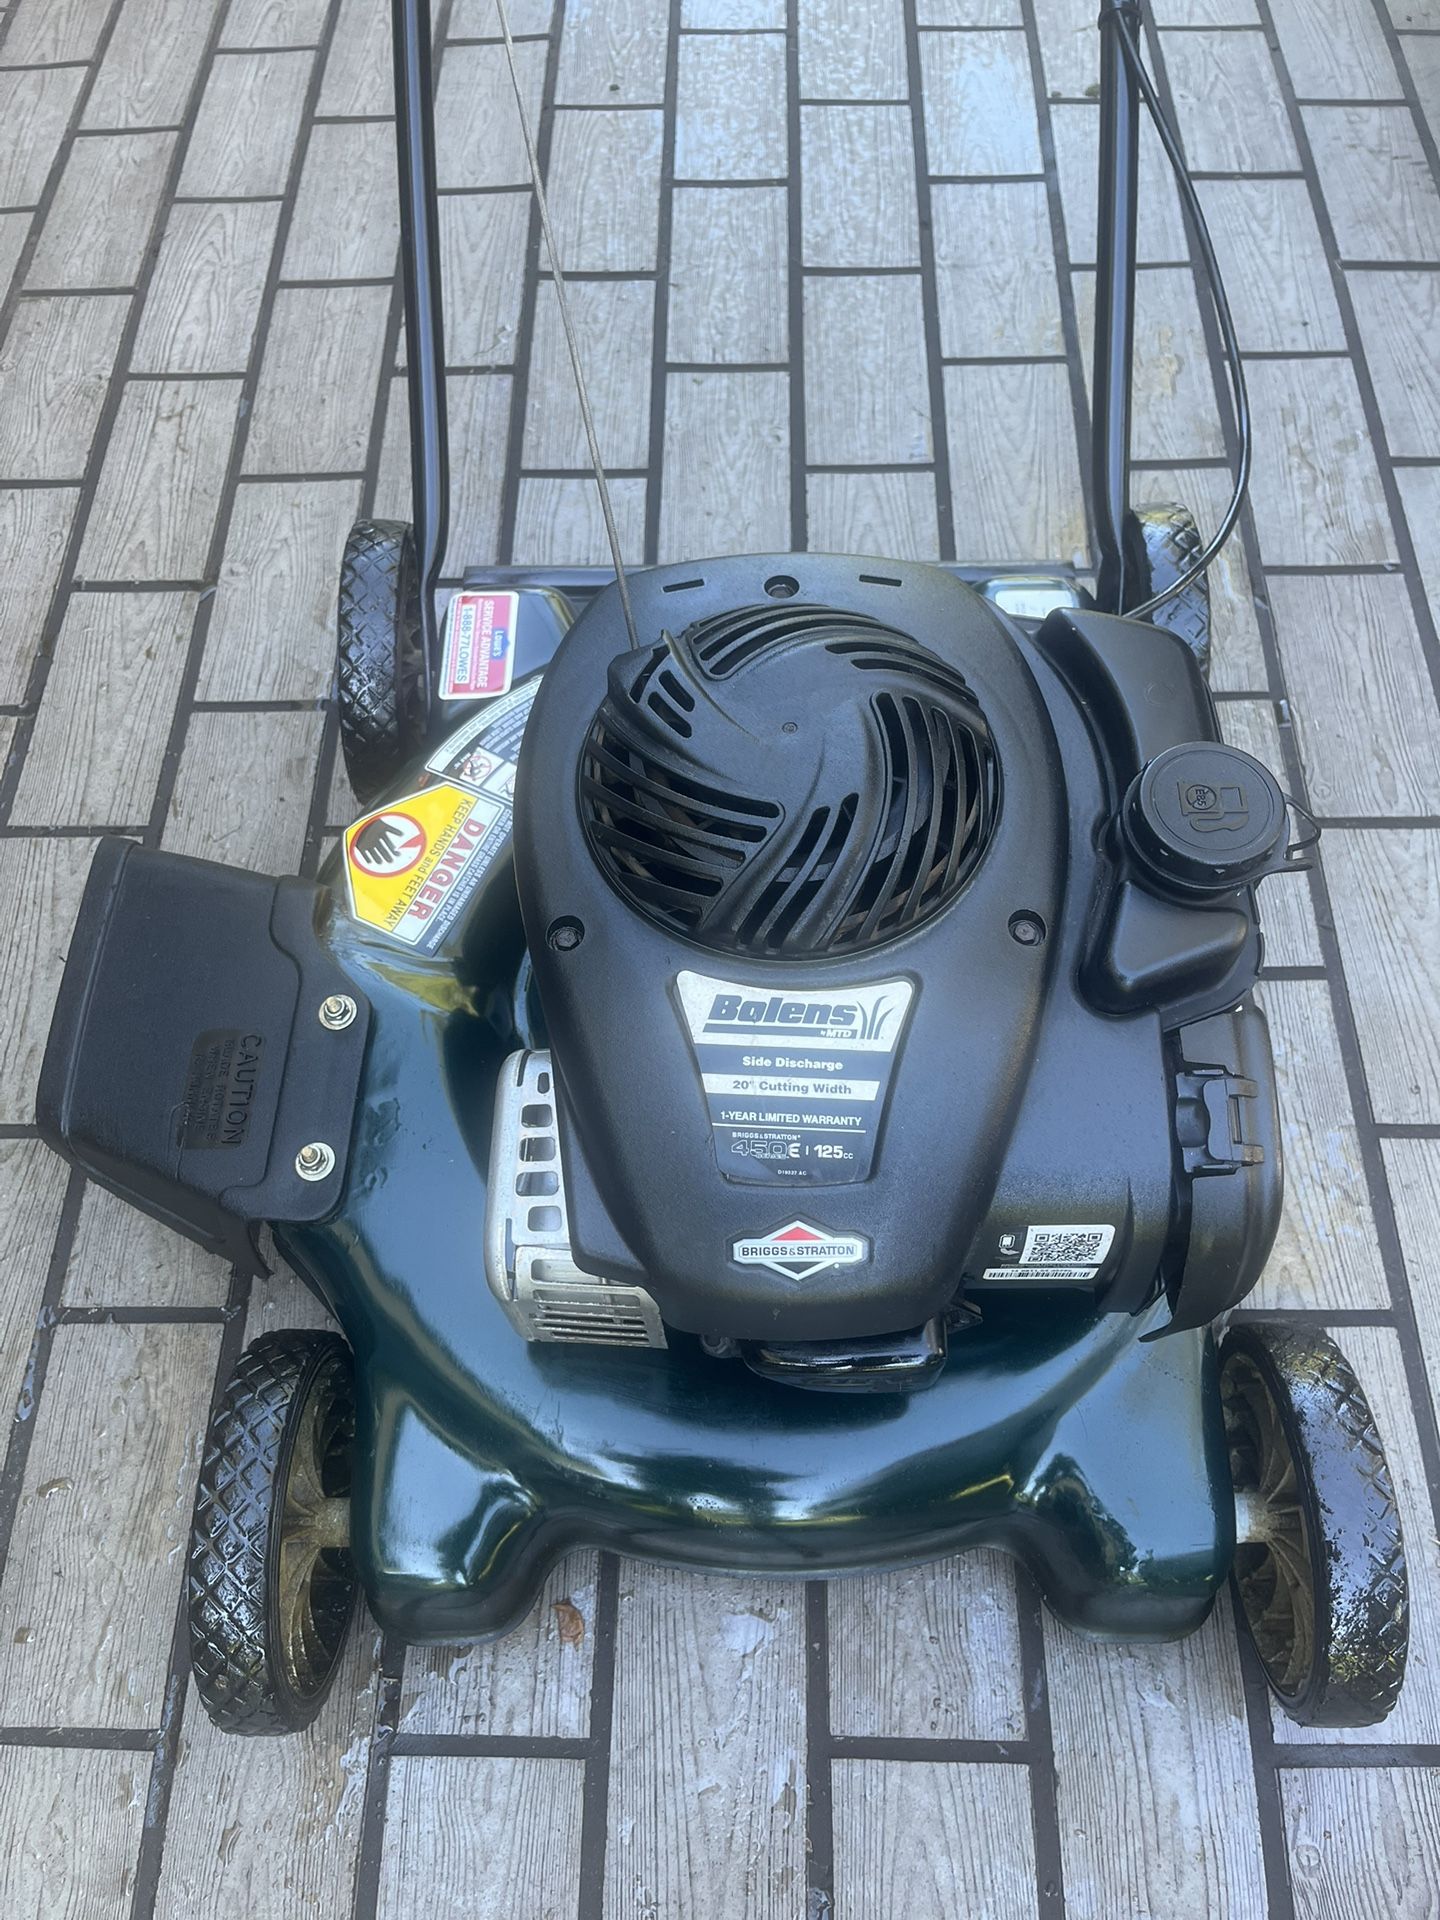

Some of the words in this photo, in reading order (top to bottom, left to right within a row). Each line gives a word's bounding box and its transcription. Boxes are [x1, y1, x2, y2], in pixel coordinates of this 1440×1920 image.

[481, 600, 495, 636] SERVICE
[456, 607, 473, 682] 1-888-77LOWES
[476, 637, 492, 688] ADVANTAGE
[449, 798, 472, 824] KEEP
[428, 823, 456, 857] HANDS
[486, 830, 506, 857] OPERATE
[407, 816, 486, 923] DANGER
[417, 855, 435, 875] and
[473, 855, 491, 878] UNLESS
[401, 873, 423, 899] FEET
[382, 898, 407, 927] AWAY
[446, 885, 472, 921] UNDAMAGED
[425, 919, 451, 949] DISCHARGE
[707, 993, 858, 1026] Bolens
[825, 1029, 852, 1039] MTD
[742, 1056, 772, 1068] Side
[775, 1057, 843, 1071] Discharge
[221, 1034, 263, 1145] CAUTION
[732, 1079, 754, 1091] 20"
[759, 1080, 809, 1095] Cutting
[812, 1082, 852, 1095] Width
[720, 1111, 757, 1122] 1-YEAR
[758, 1112, 800, 1124] LIMITED
[802, 1114, 862, 1126] WARRANTY
